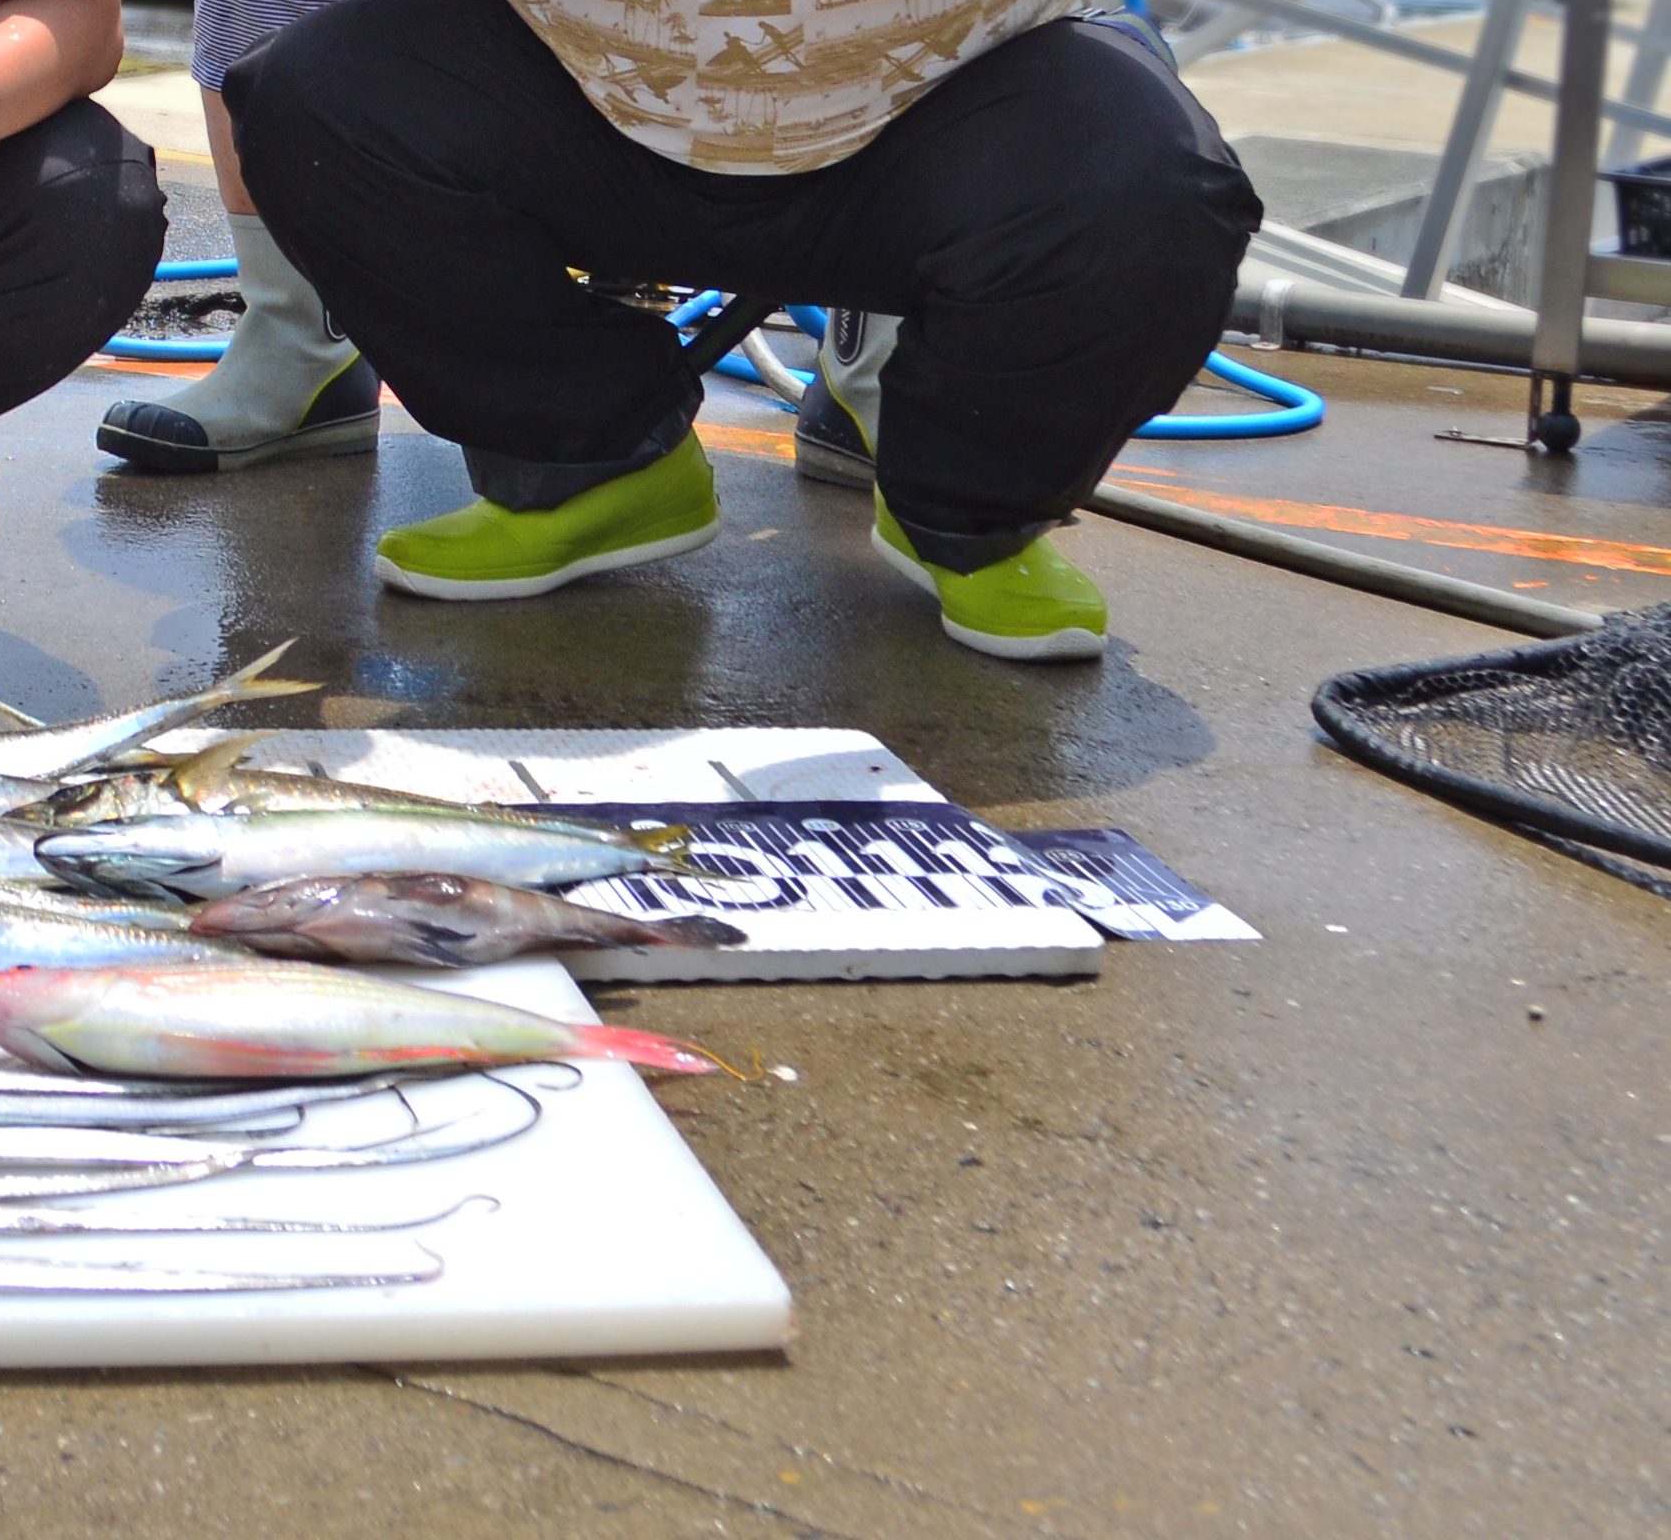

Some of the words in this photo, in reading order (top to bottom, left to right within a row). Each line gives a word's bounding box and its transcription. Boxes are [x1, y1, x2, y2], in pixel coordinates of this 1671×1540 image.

[723, 821, 751, 831] 105
[809, 821, 835, 830] 110
[894, 821, 920, 830] 115
[1050, 849, 1080, 861] 125
[1155, 898, 1199, 912] 130
